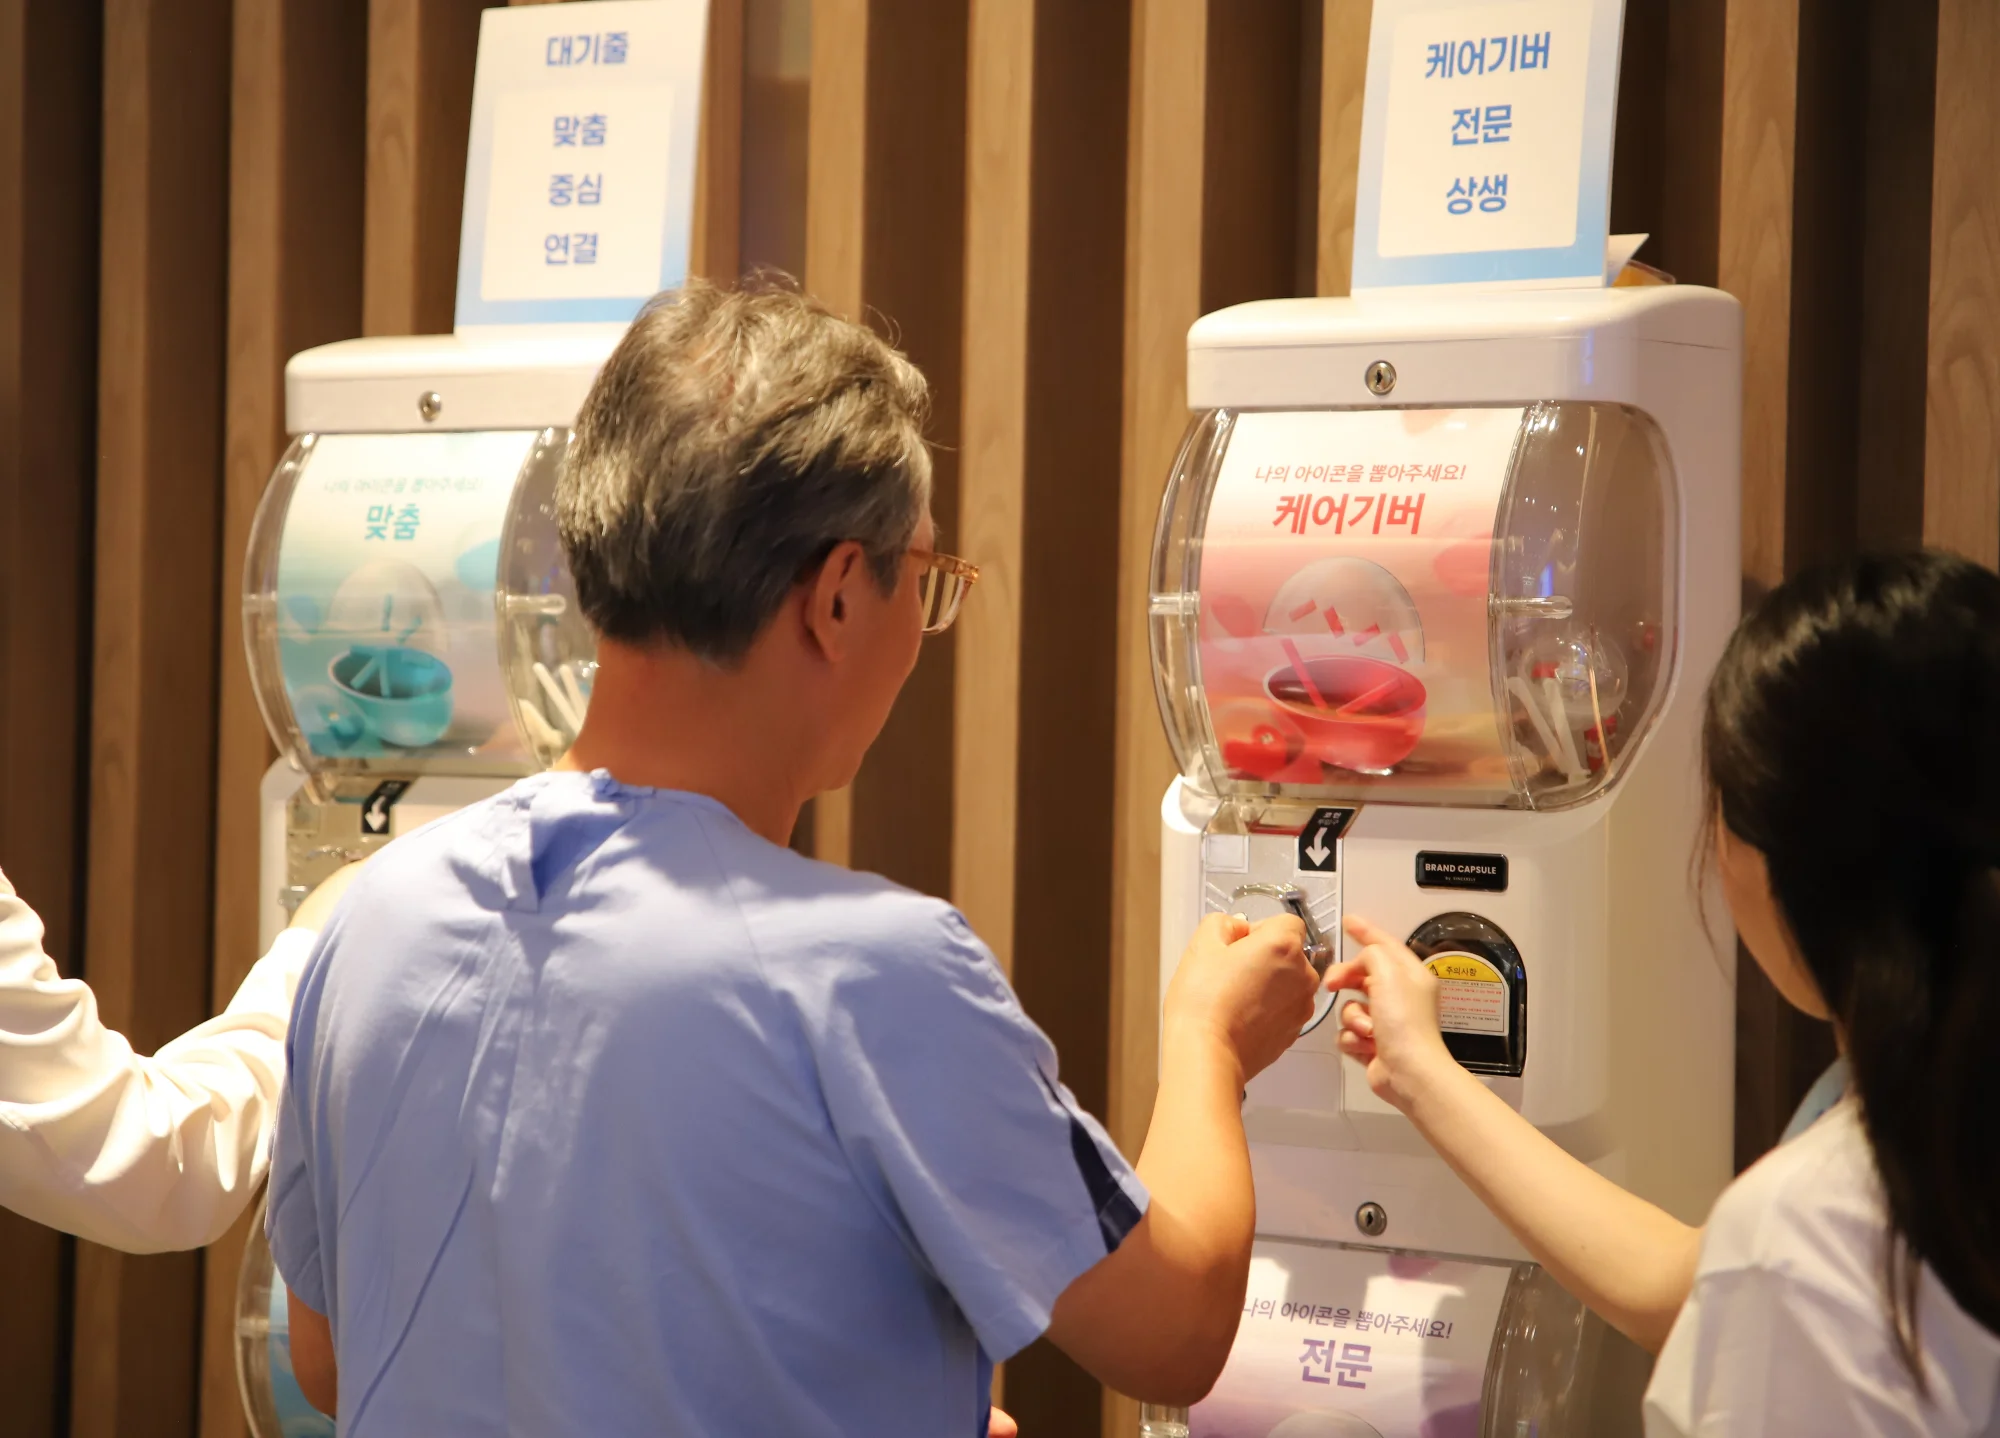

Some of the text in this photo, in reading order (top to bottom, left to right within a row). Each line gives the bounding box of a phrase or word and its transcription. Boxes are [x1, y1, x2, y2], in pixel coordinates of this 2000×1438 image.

[545, 31, 630, 67] 대기줄
[1425, 31, 1551, 78] 케어기버
[553, 114, 607, 147] 맞춤
[1451, 104, 1512, 146] 전문
[548, 173, 603, 207] 중심
[1446, 174, 1508, 215] 상생
[544, 233, 599, 266] 연결
[1255, 463, 1467, 483] 나의 아이콘을 뽑아주세요!
[364, 503, 420, 541] 맞춤
[1272, 493, 1426, 535] 케어기버
[1425, 863, 1497, 875] BRAND CAPSULE
[1446, 966, 1477, 977] 주의사항
[1281, 1302, 1351, 1329] 아이콘을
[1355, 1310, 1453, 1339] 뽑아주세요!
[1299, 1338, 1373, 1389] 전문
